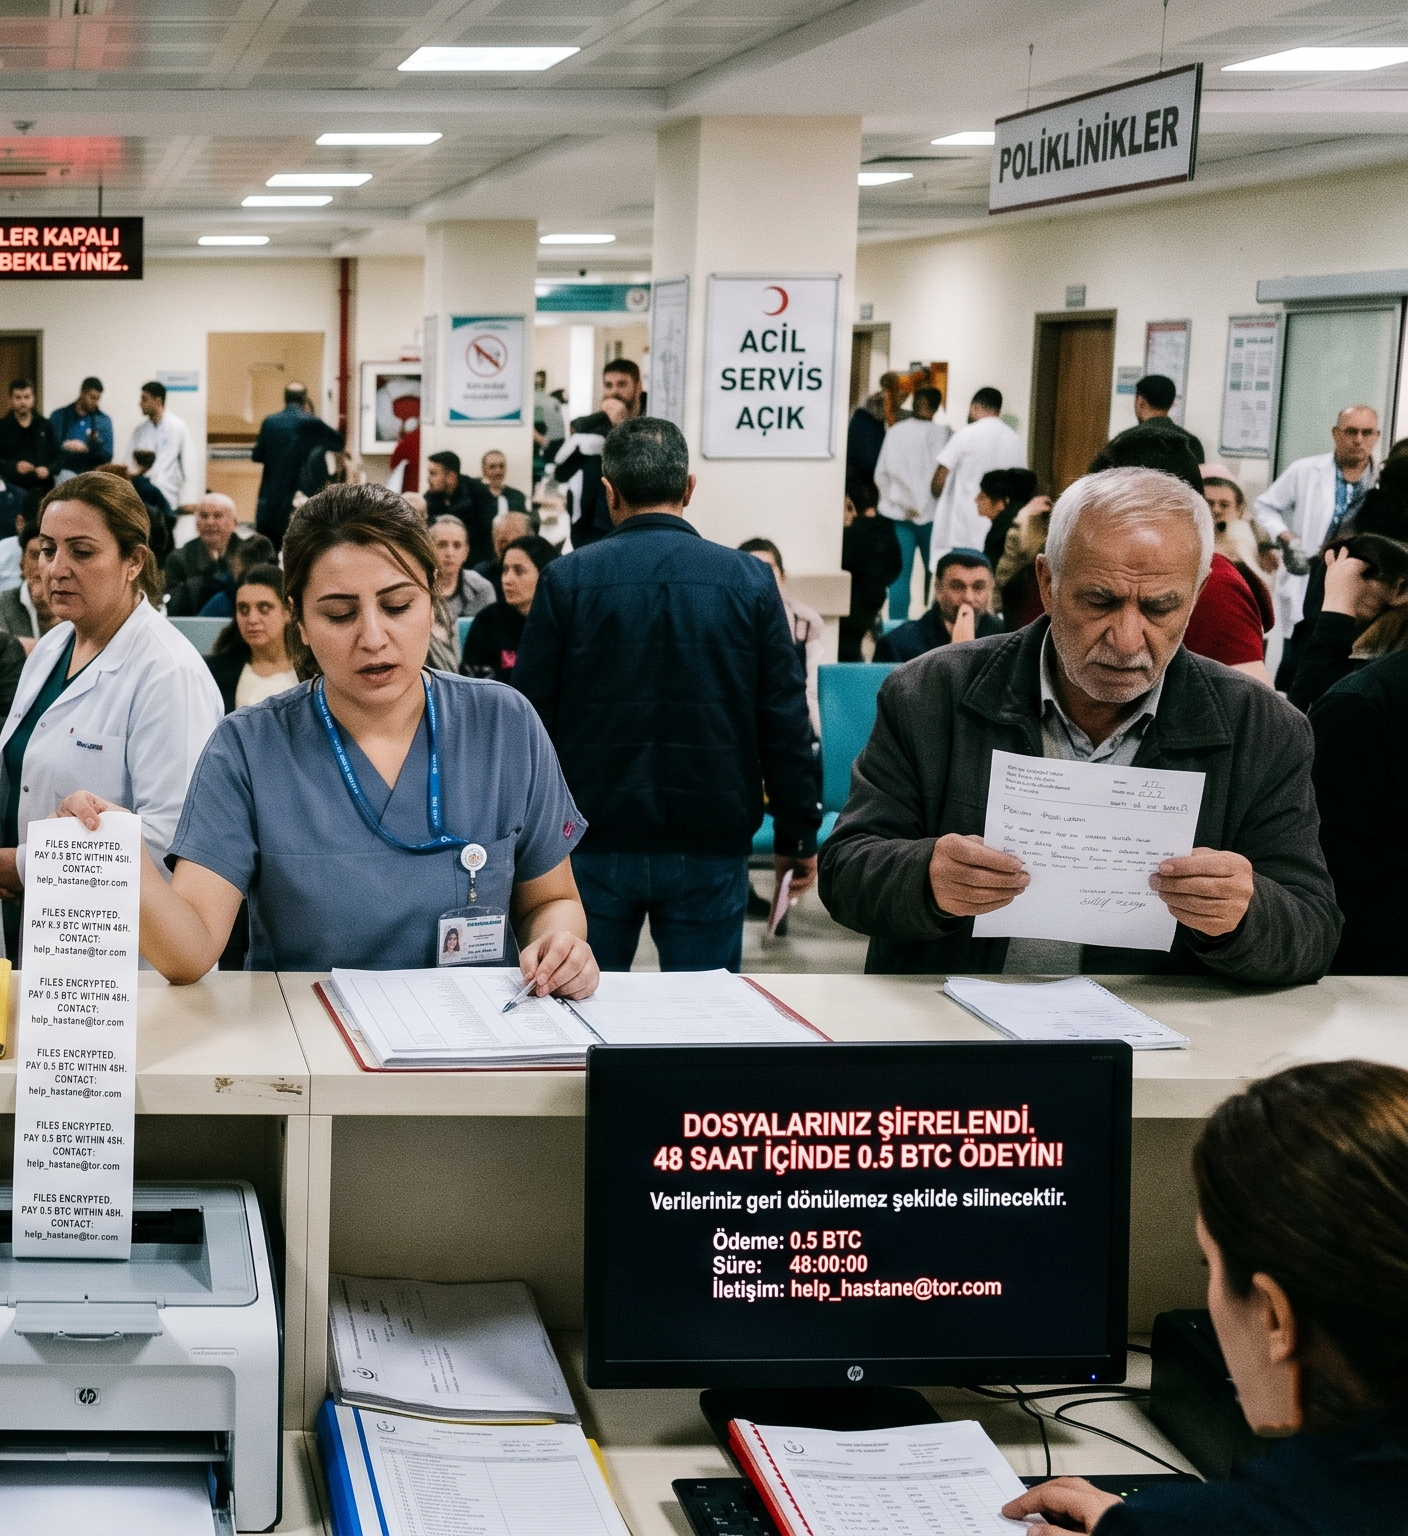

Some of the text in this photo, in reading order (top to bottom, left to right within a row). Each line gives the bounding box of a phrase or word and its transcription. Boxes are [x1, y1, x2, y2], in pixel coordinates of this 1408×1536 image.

[998, 105, 1180, 184] POLİKLİNİKLER
[42, 226, 120, 247] KAPALI
[739, 322, 806, 354] ACİL
[720, 361, 823, 392] SERVİS
[736, 406, 805, 436] AÇIK
[45, 839, 123, 851] FILES ENCRYPTED.
[34, 851, 49, 860] PAY
[66, 853, 82, 861] BTC
[85, 853, 113, 862] WITHIN
[62, 865, 103, 874] CONTACT:
[37, 875, 128, 888] help_hastane@tor.com
[42, 908, 120, 919] FILES ENCRYPTED.
[31, 920, 46, 928] PAY
[63, 921, 79, 930] BTC
[82, 923, 111, 931] WITHIN
[59, 934, 100, 943] CONTACT:
[33, 945, 126, 957] help_hastane@tor.com
[40, 978, 118, 988] FILES ENCRYPTED.
[29, 990, 43, 998] PAY
[61, 991, 77, 1000] BTC
[80, 992, 109, 1000] WITHIN
[57, 1004, 99, 1013] CONTACT:
[31, 1015, 124, 1027] help_hastane@tor.com
[37, 1049, 115, 1059] FILES ENCRYPTED.
[26, 1061, 41, 1069] PAY
[43, 1062, 56, 1070] 0.5
[58, 1062, 75, 1070] BTC
[78, 1063, 107, 1072] WITHIN
[55, 1075, 96, 1084] CONTACT:
[28, 1086, 121, 1098] help_hastane@tor.com
[36, 1121, 113, 1131] FILES ENCRYPTED.
[684, 1104, 1035, 1141] DOSYALARINIZ ŞİFRELENDİ.
[42, 1134, 54, 1142] 0.5
[56, 1135, 72, 1143] BTC
[75, 1136, 104, 1144] WITHIN
[53, 1147, 95, 1156] CONTACT:
[654, 1138, 1064, 1174] 48 SAAT İÇİNDE 0.5 BTC ÖDEYİN!
[27, 1159, 119, 1171] help_hastane@tor.com
[33, 1193, 112, 1204] FILES ENCRYPTED.
[650, 1187, 1067, 1214] Verileriniz geri dönülemez şekilde silinecektir.
[21, 1206, 37, 1214] PAY
[40, 1207, 52, 1215] 0.5
[54, 1207, 71, 1215] BTC
[74, 1208, 103, 1216] WITHIN
[51, 1219, 93, 1228] CONTACT:
[25, 1230, 118, 1241] help_hastane@tor.com
[713, 1228, 862, 1252] Ödeme: 0.5 BTC
[713, 1255, 868, 1275] Süre: 48:00:00
[712, 1276, 1002, 1303] İletişim: help_hastane@tor.com
